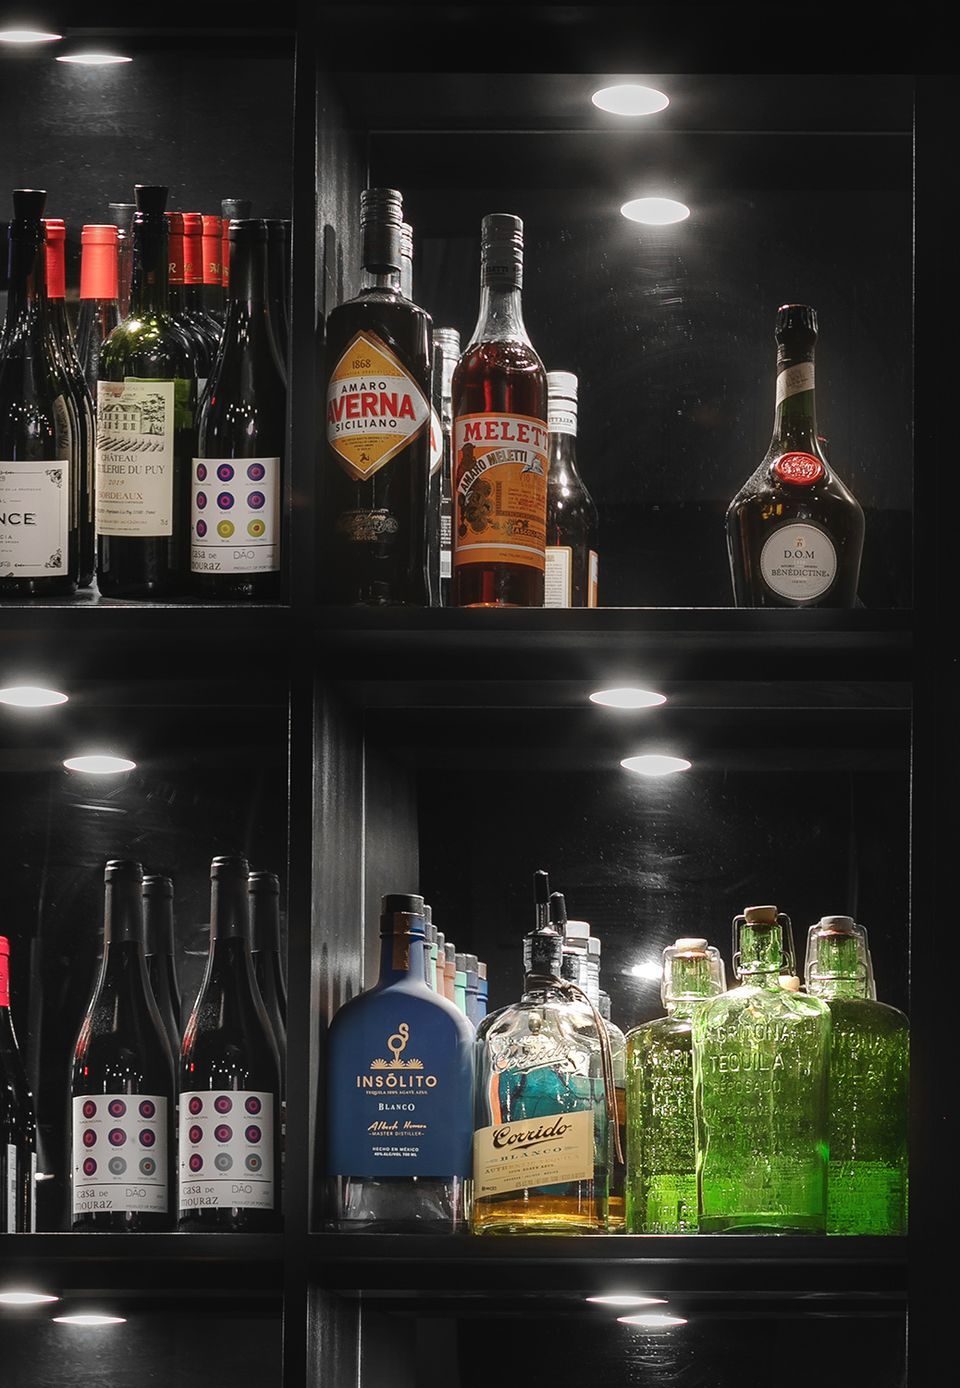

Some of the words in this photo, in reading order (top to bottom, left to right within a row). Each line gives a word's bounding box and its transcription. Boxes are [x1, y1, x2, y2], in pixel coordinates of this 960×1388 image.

[352, 359, 371, 370] 1868
[341, 381, 387, 394] AMARO
[328, 392, 416, 424] AVERNA
[335, 419, 397, 432] SICILIANO
[487, 449, 528, 465] MELETTI
[128, 464, 142, 474] DU
[145, 465, 165, 474] PUY
[771, 565, 828, 577] BÉNÉDICTINE
[709, 1051, 785, 1074] TEQUILA
[356, 1072, 438, 1088] INSÓLITO
[492, 1116, 572, 1149] Corrido
